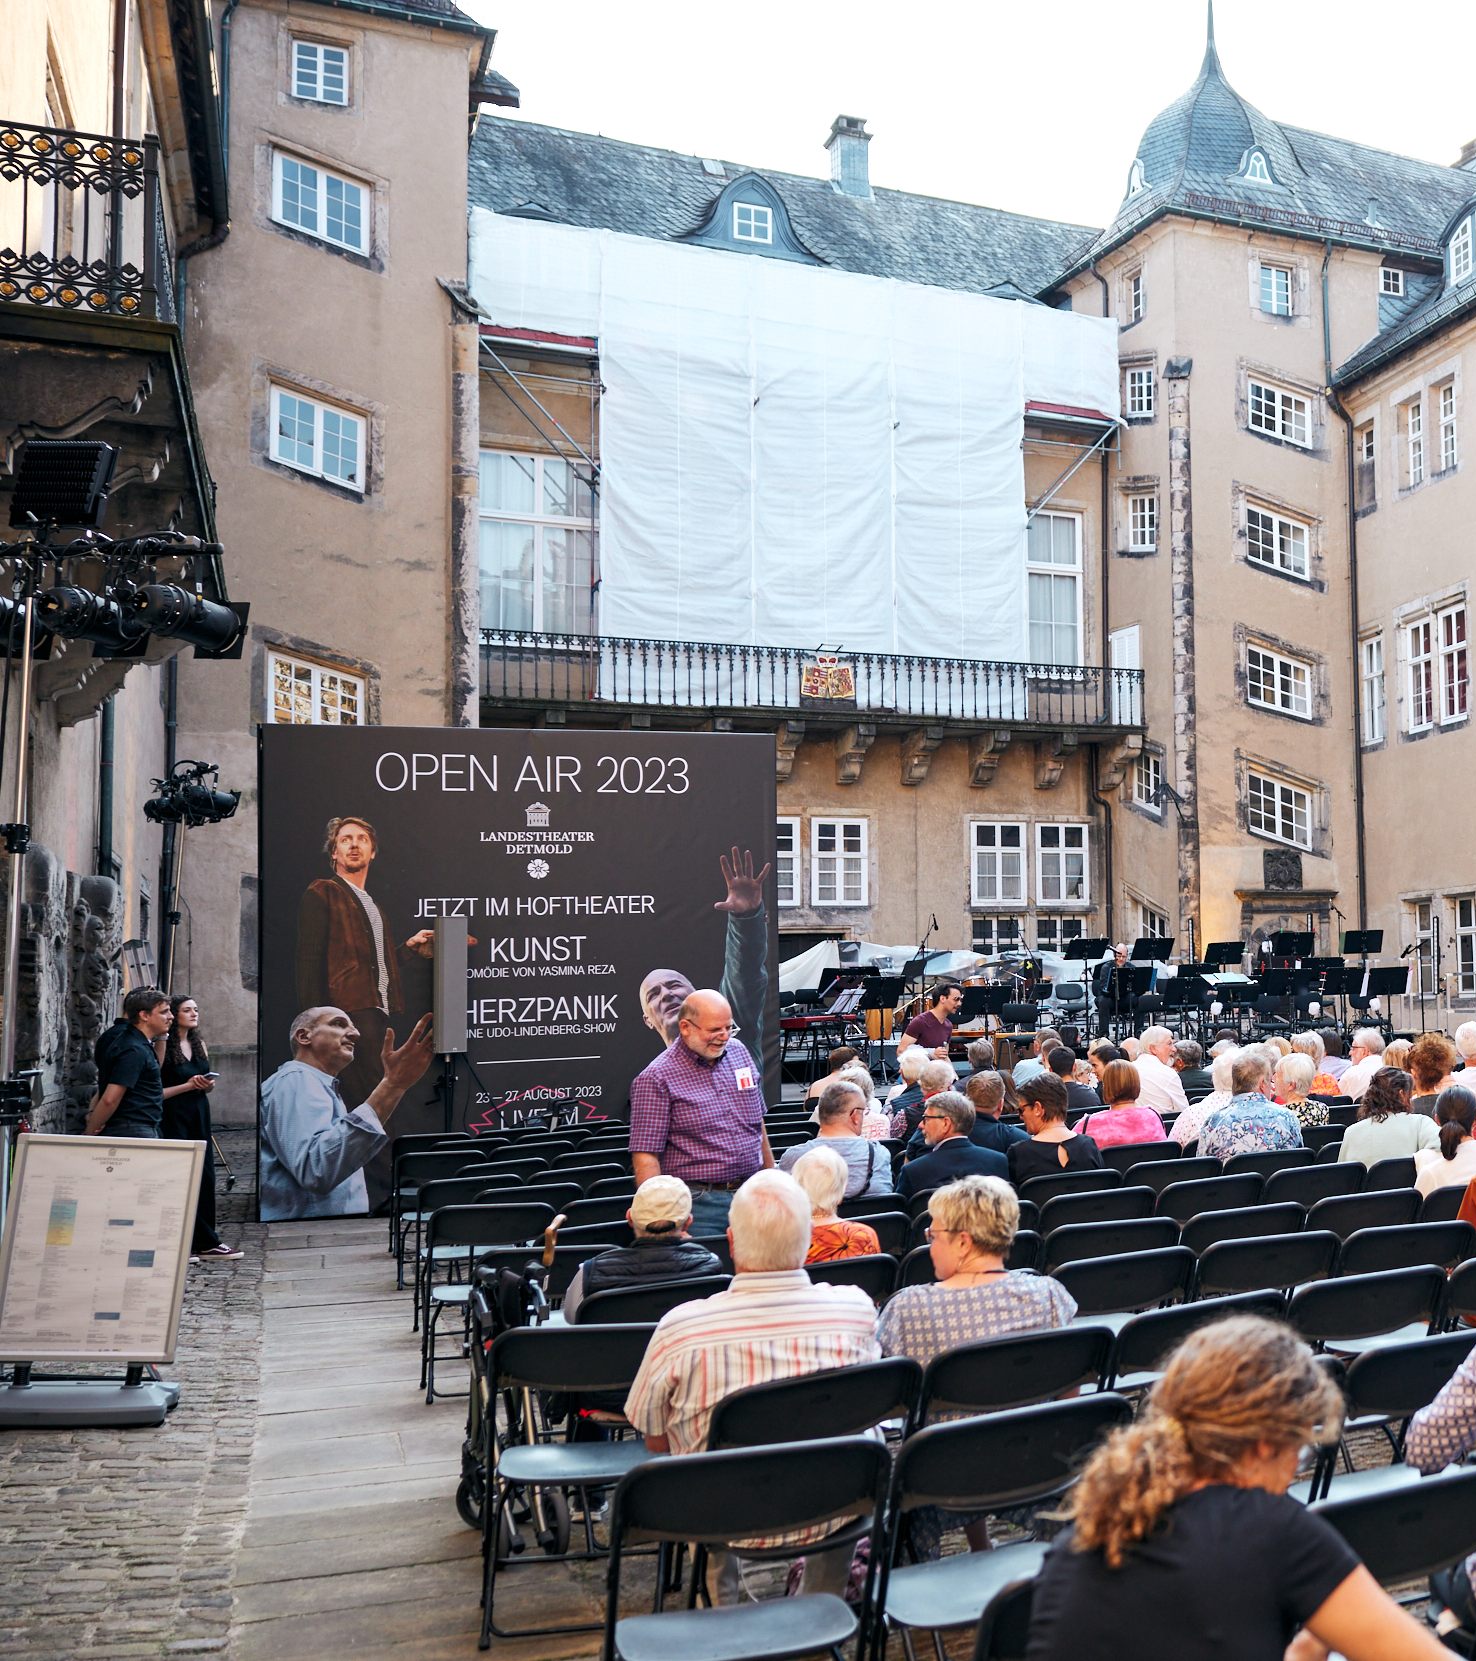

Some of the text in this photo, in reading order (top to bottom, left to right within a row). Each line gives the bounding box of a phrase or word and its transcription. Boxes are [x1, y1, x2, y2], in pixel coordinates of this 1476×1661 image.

[374, 751, 690, 795] OPEN AIR 2023
[480, 831, 596, 842] LANDESTHEATER
[506, 843, 573, 855] DETMOLD
[414, 894, 655, 918] JETZT IM HOFTHEATER
[490, 936, 587, 963] KUNST
[466, 964, 617, 979] OMÖDIE VON YASMINA REZA
[466, 994, 619, 1025] HERZPANIK
[466, 1022, 617, 1039] INE UDO-LINDENBERG-SHOW
[504, 1090, 520, 1102] 27.
[522, 1087, 572, 1101] AUGUST
[574, 1085, 602, 1098] 2023
